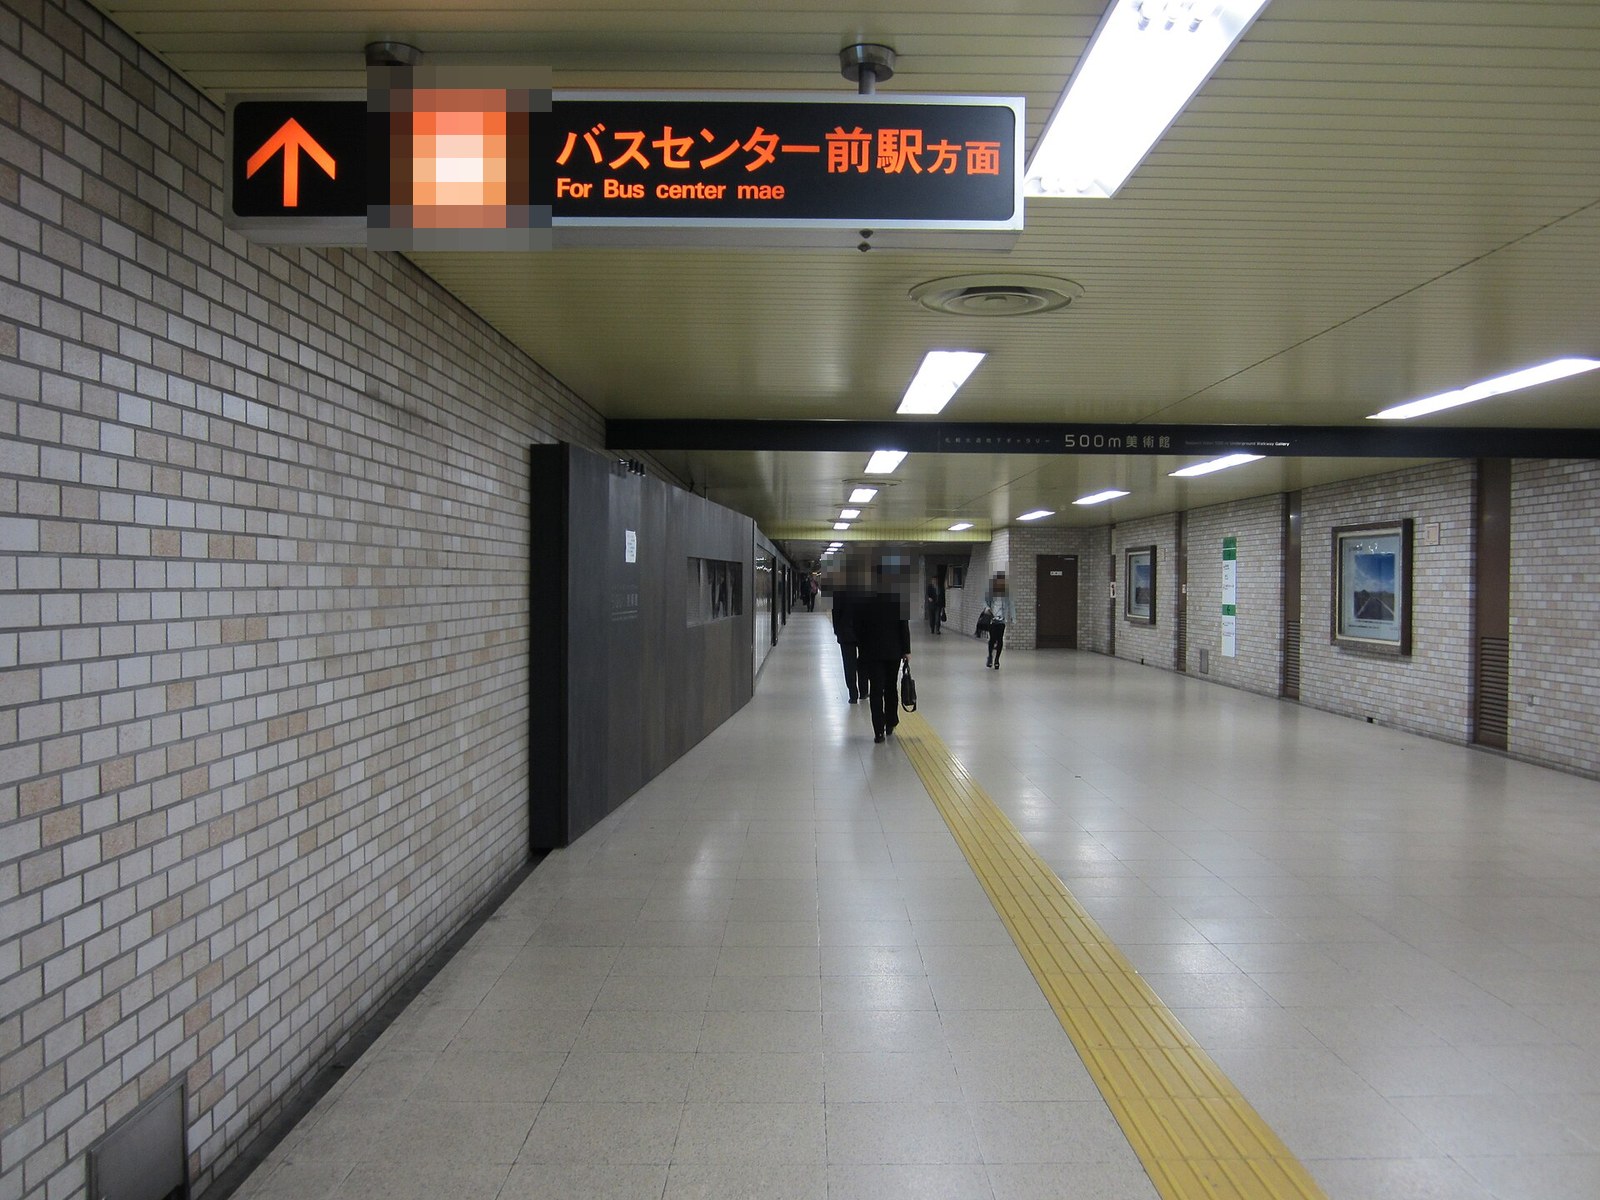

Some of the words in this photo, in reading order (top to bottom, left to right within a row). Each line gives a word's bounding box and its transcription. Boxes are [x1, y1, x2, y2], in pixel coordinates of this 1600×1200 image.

[555, 123, 1000, 175] バスセンター前駅方面
[556, 178, 593, 199] For
[603, 179, 645, 199] Bus
[655, 181, 727, 200] center
[737, 184, 785, 200] mae
[1064, 434, 1170, 448] 500m美術館
